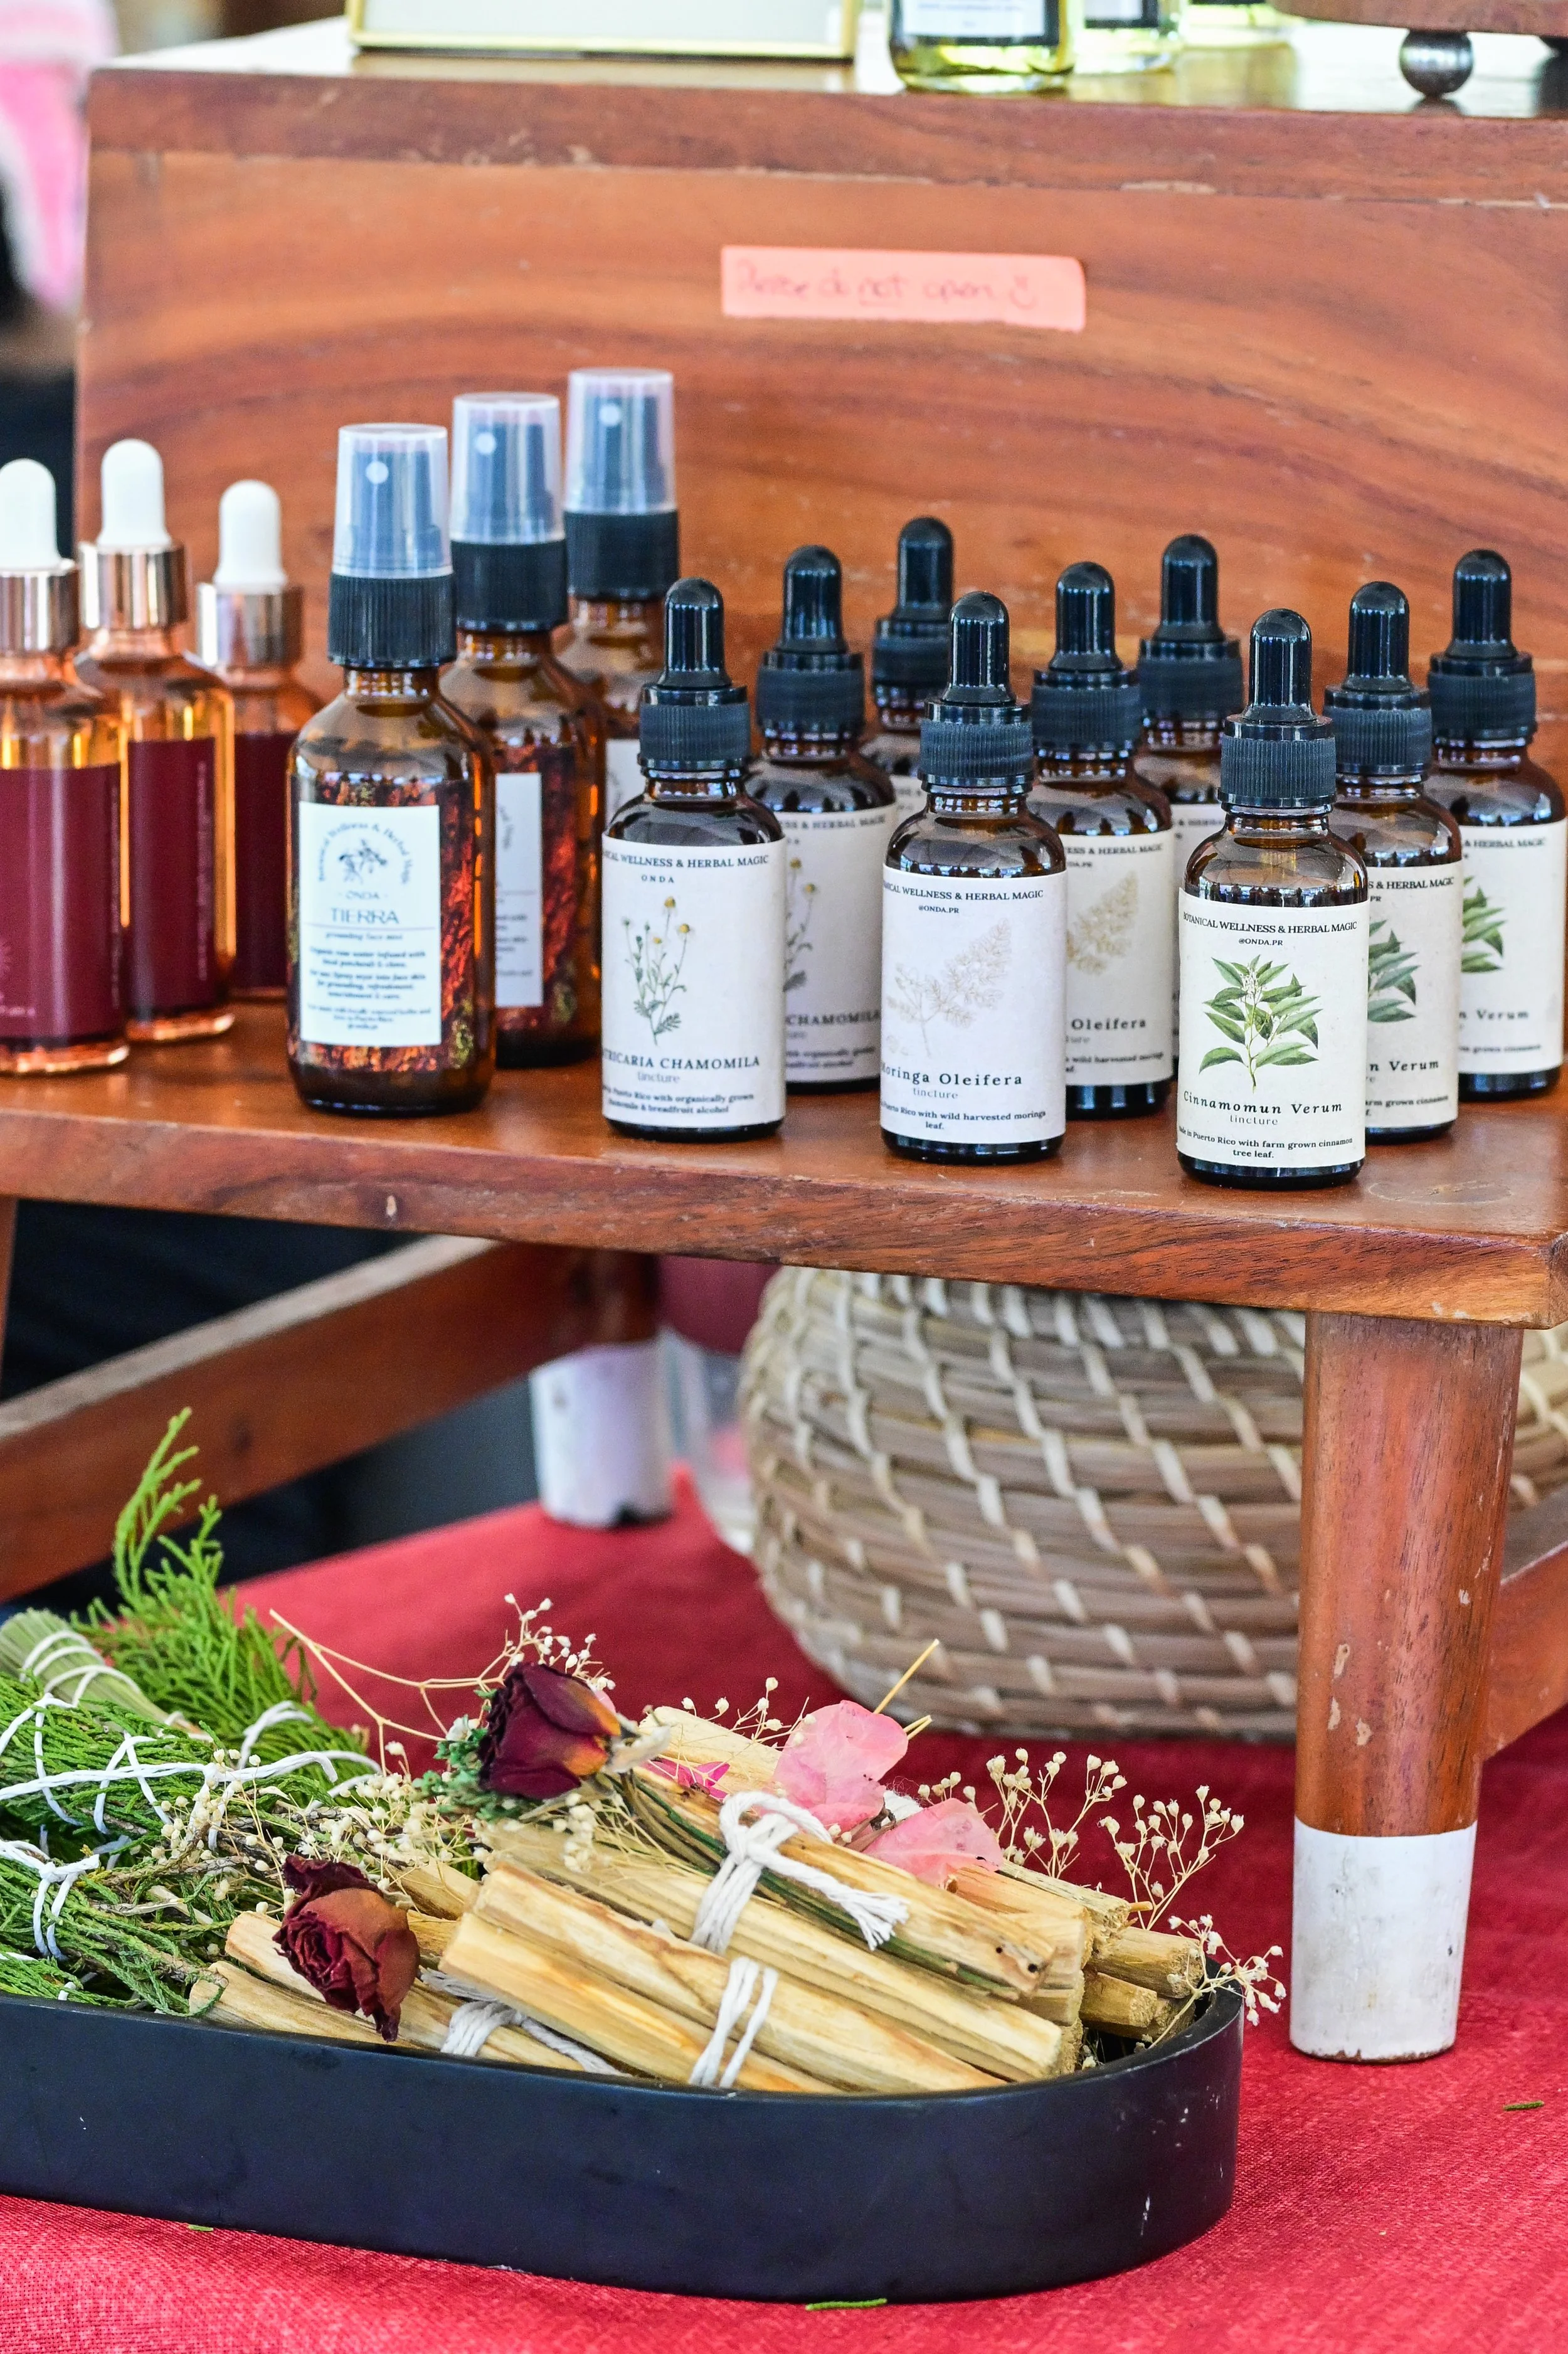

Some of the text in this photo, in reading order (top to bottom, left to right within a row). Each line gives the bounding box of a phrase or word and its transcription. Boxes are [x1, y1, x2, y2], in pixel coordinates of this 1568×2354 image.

[620, 855, 672, 867] WELLNESS
[676, 859, 683, 867] &
[688, 858, 733, 867] HERBAL
[738, 854, 770, 867] MAGIC
[1387, 880, 1428, 889] HERBAL
[1430, 877, 1454, 887] MAGIC
[903, 886, 952, 899] WELLNESS
[1012, 889, 1043, 900] MAGIC
[331, 907, 400, 924] TIERRA
[918, 905, 959, 914] @ONDA.PR
[1184, 911, 1217, 928] BOTANICAL
[1219, 921, 1276, 933] WELLNESS
[1288, 925, 1329, 933] HERBAL
[1331, 921, 1357, 932] MAGIC
[1476, 1009, 1528, 1019] Verum
[1071, 1018, 1146, 1030] Oleifera
[660, 1056, 760, 1069] CHAMOMILA
[1389, 1061, 1439, 1071] Verum
[637, 1071, 680, 1083] tincture
[940, 1073, 1022, 1086] Oleifera
[635, 1091, 650, 1100] Rico
[675, 1095, 725, 1104] organically
[913, 1088, 958, 1099] tincture
[1184, 1091, 1342, 1114] Cinnamomun Verum
[648, 1105, 693, 1113] breadfruit
[696, 1105, 729, 1113] alcohol
[901, 1106, 916, 1116] Rico
[963, 1113, 1011, 1121] harvested
[925, 1121, 945, 1130] leaf.
[1230, 1115, 1278, 1125] tincture
[1193, 1132, 1216, 1143] Puerto
[1217, 1137, 1236, 1145] Rico
[1288, 1142, 1316, 1150] grown
[1318, 1137, 1353, 1147] cinnamon
[1233, 1149, 1274, 1158] tree leaf.
